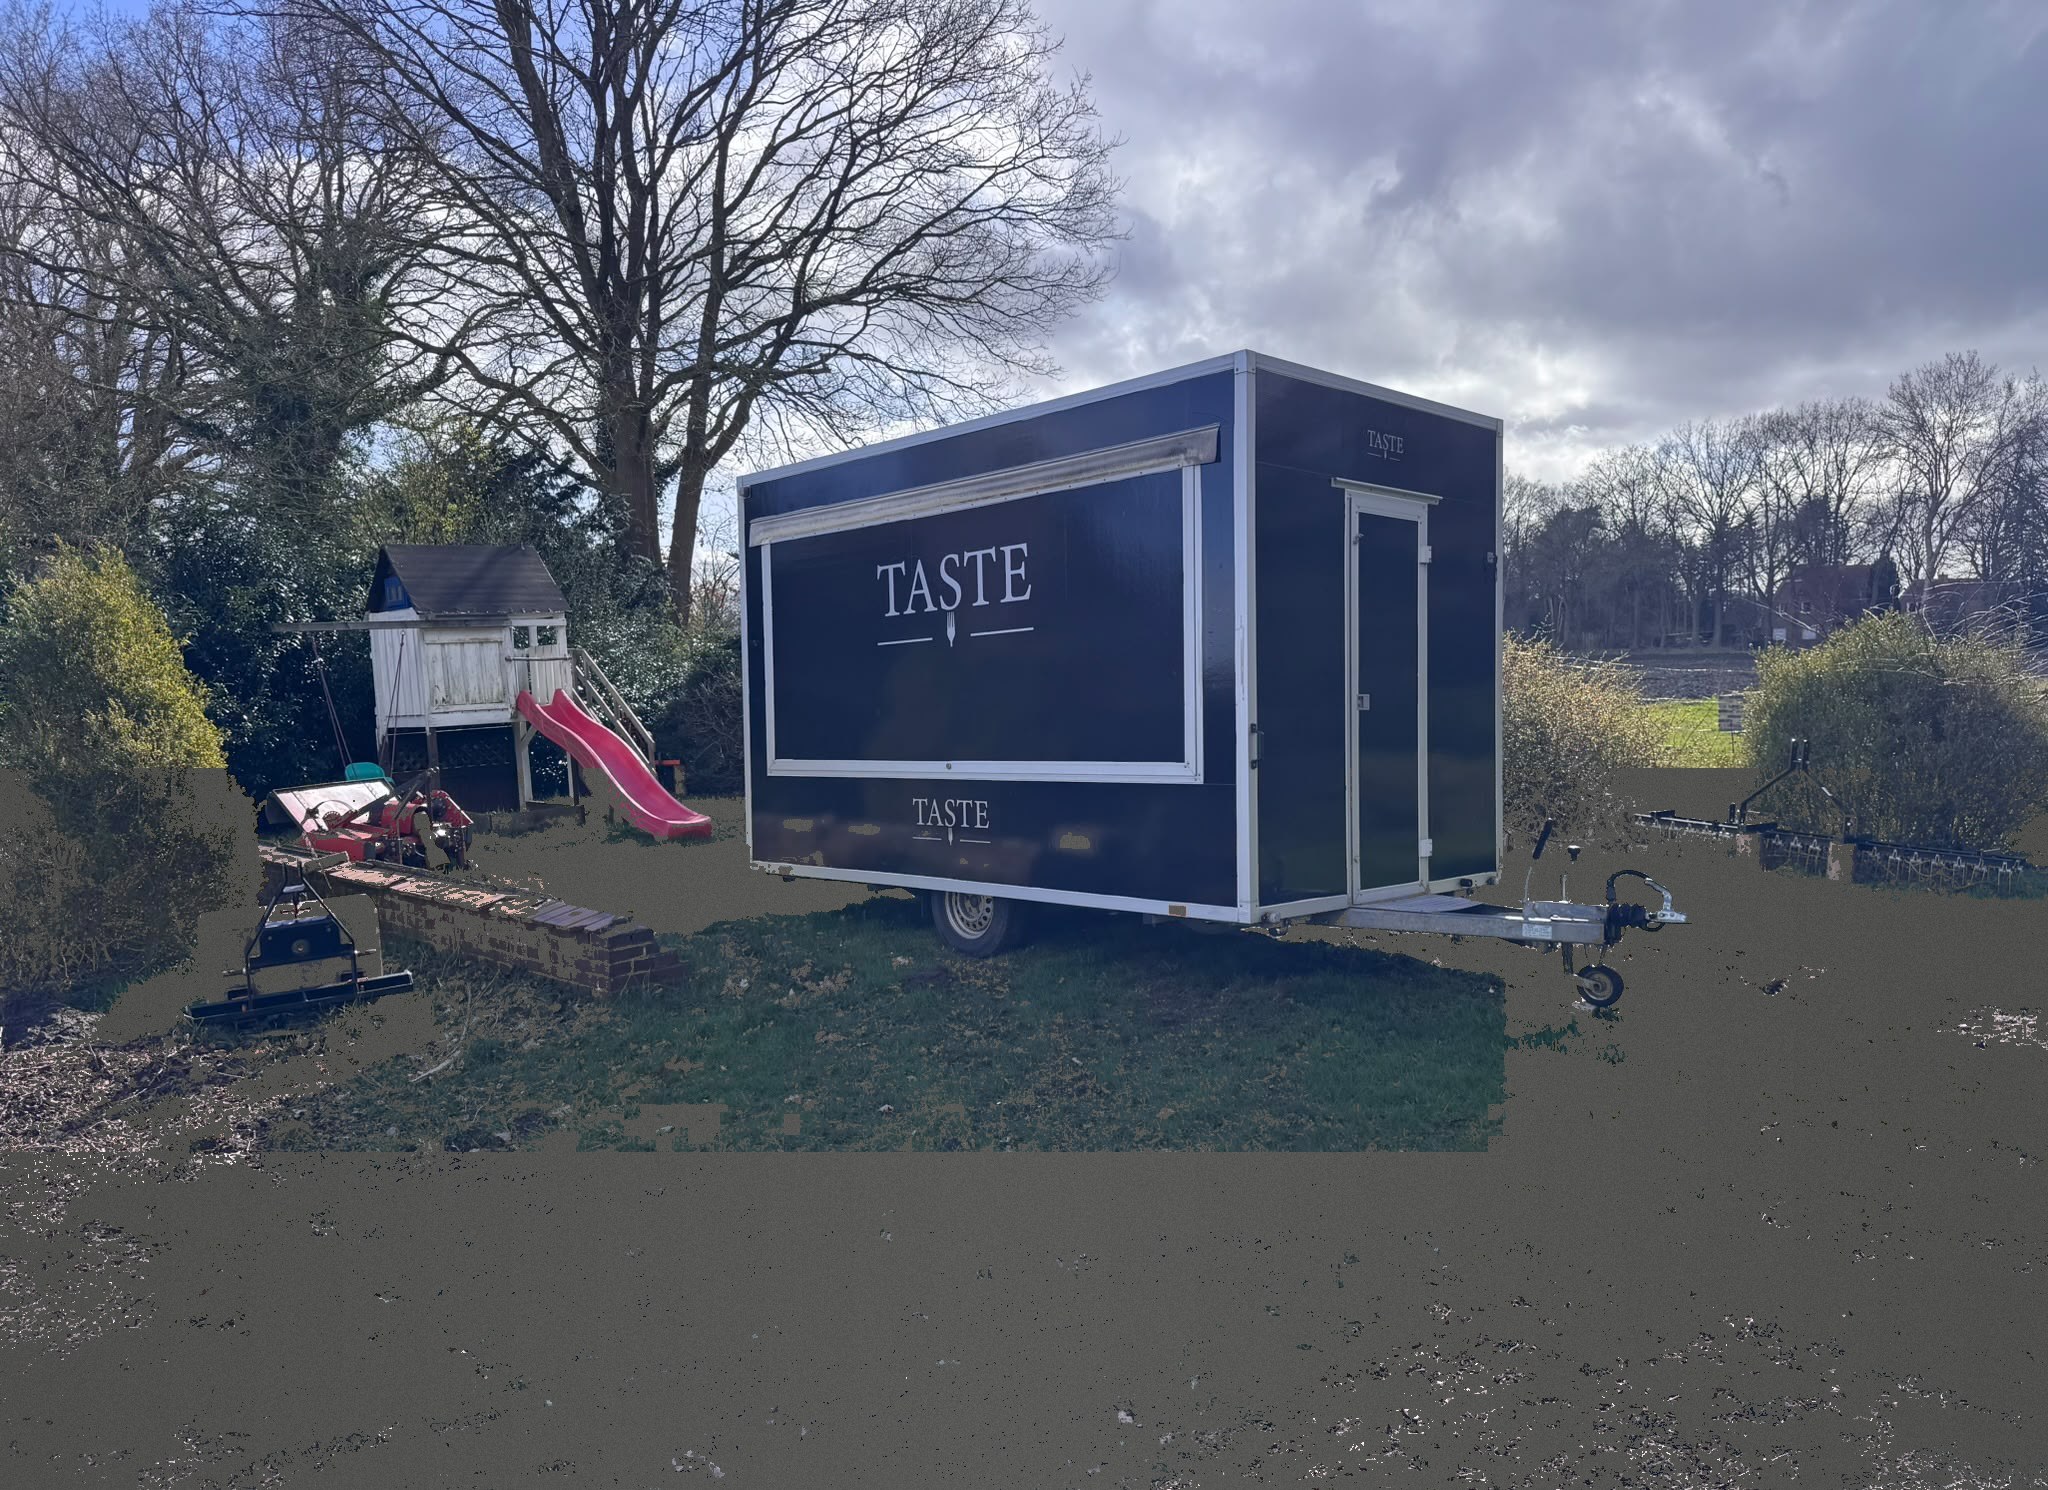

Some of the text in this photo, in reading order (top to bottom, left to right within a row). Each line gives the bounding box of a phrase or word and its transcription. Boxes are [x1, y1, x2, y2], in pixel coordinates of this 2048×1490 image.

[1367, 429, 1404, 454] TASTE
[876, 542, 1032, 617] TASTE
[912, 797, 990, 829] TASTE
